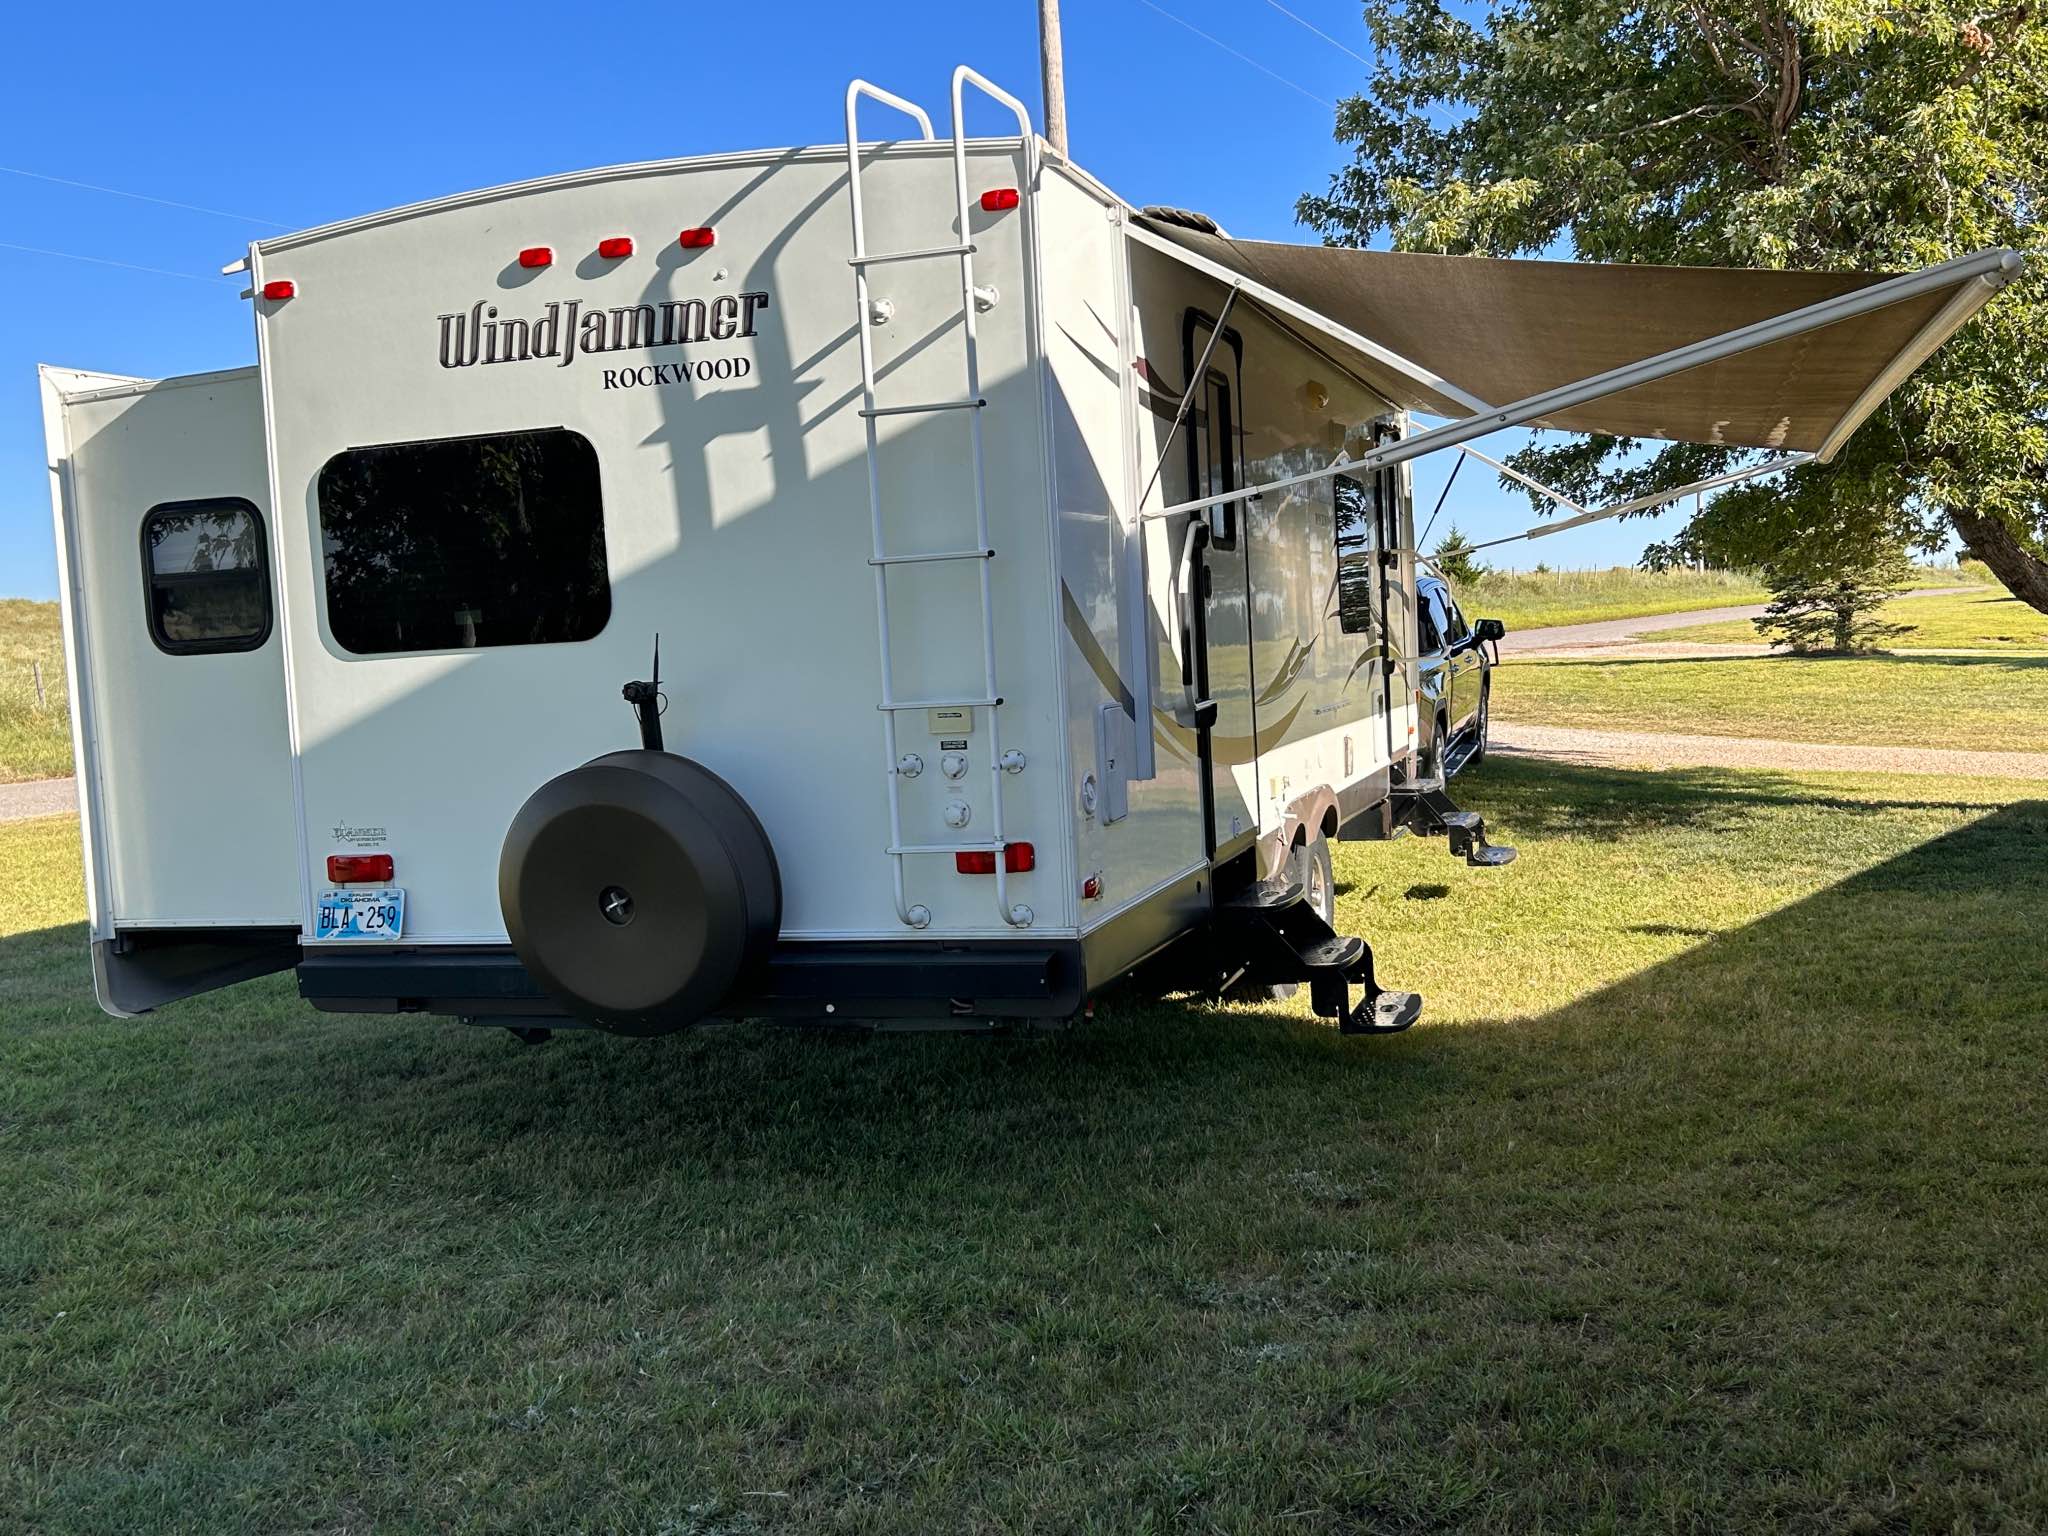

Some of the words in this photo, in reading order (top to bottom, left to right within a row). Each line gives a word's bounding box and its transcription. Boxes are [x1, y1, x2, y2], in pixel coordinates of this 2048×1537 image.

[437, 291, 769, 369] WindJammer
[602, 357, 751, 390] ROCKWOOD
[321, 906, 350, 929] BLA
[366, 906, 397, 929] 259
